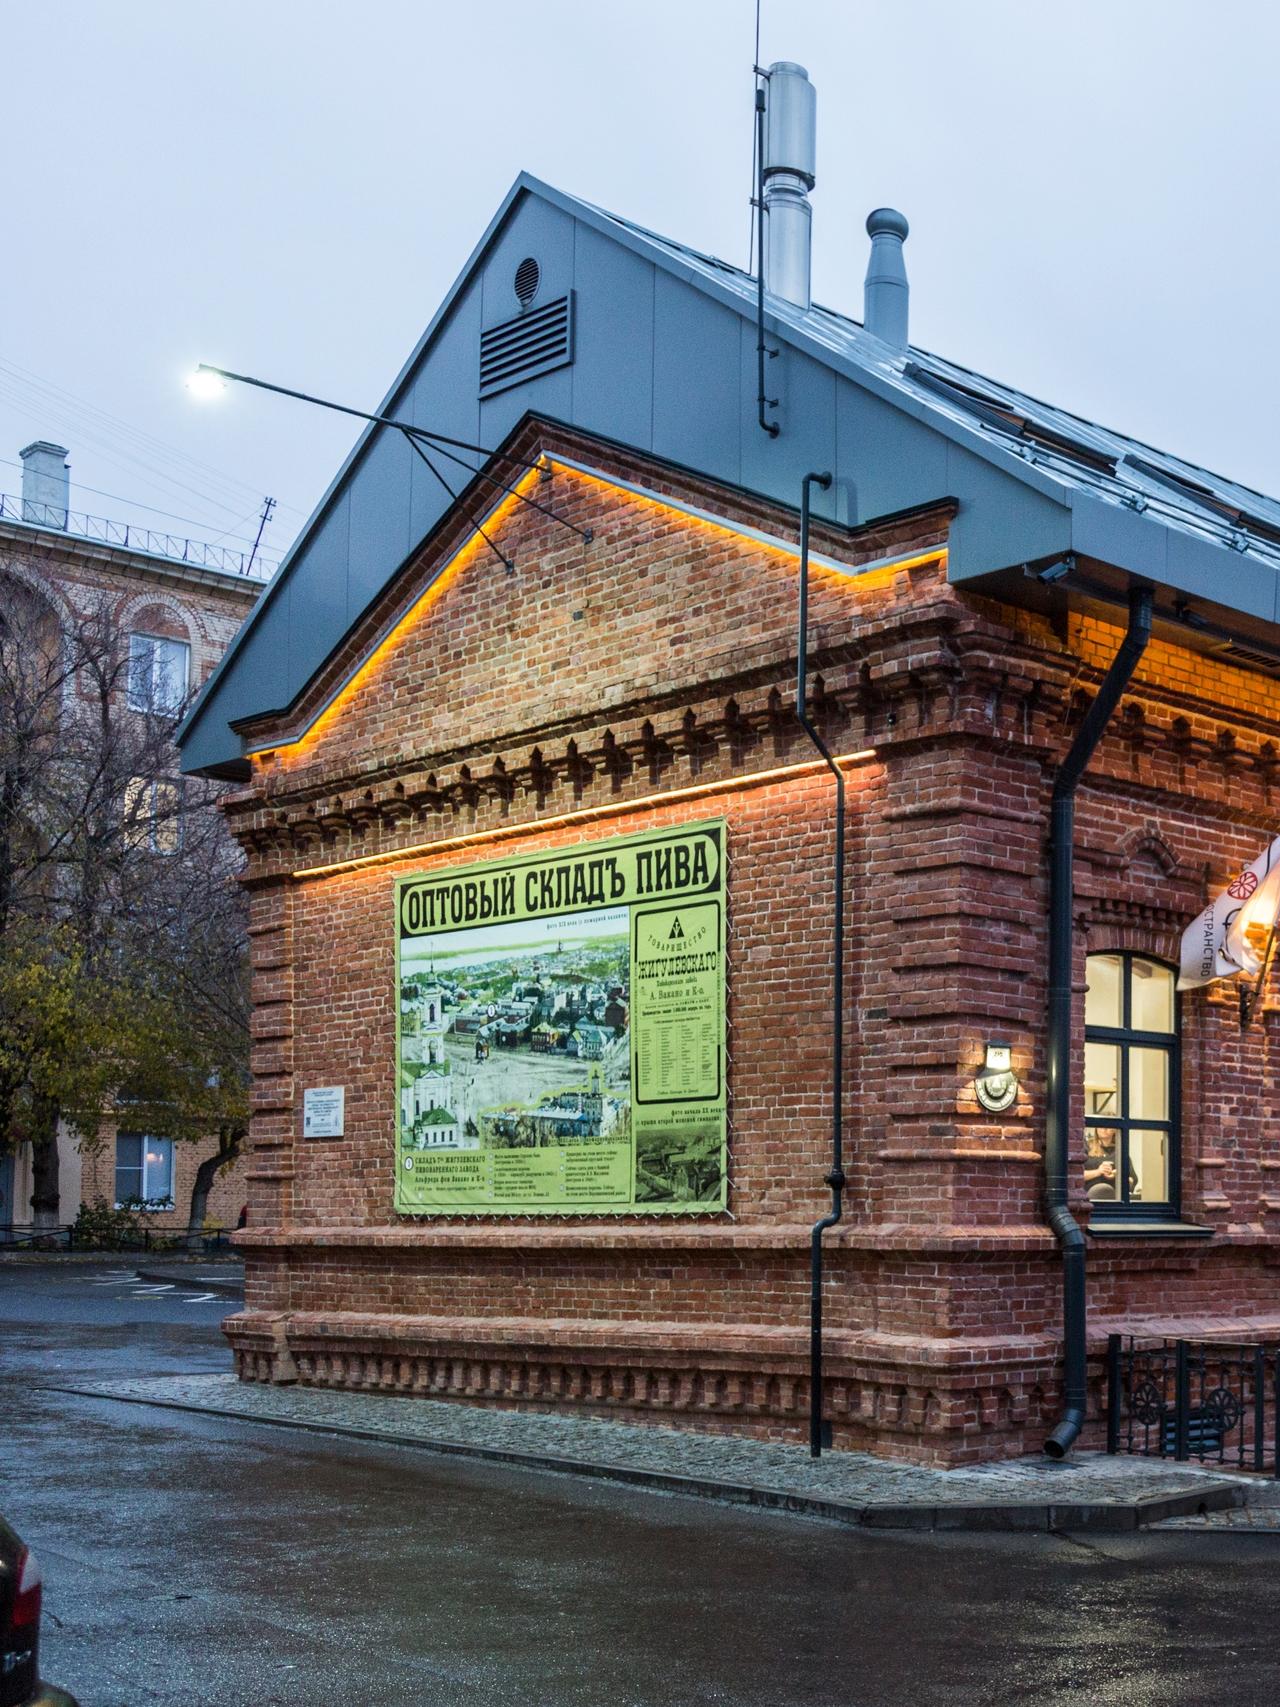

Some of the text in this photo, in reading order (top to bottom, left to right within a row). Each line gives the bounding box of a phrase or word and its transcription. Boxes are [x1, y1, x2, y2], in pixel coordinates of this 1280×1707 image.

[408, 841, 710, 930] ОПТОВЫЙ СКЛАДЪ ПИВА
